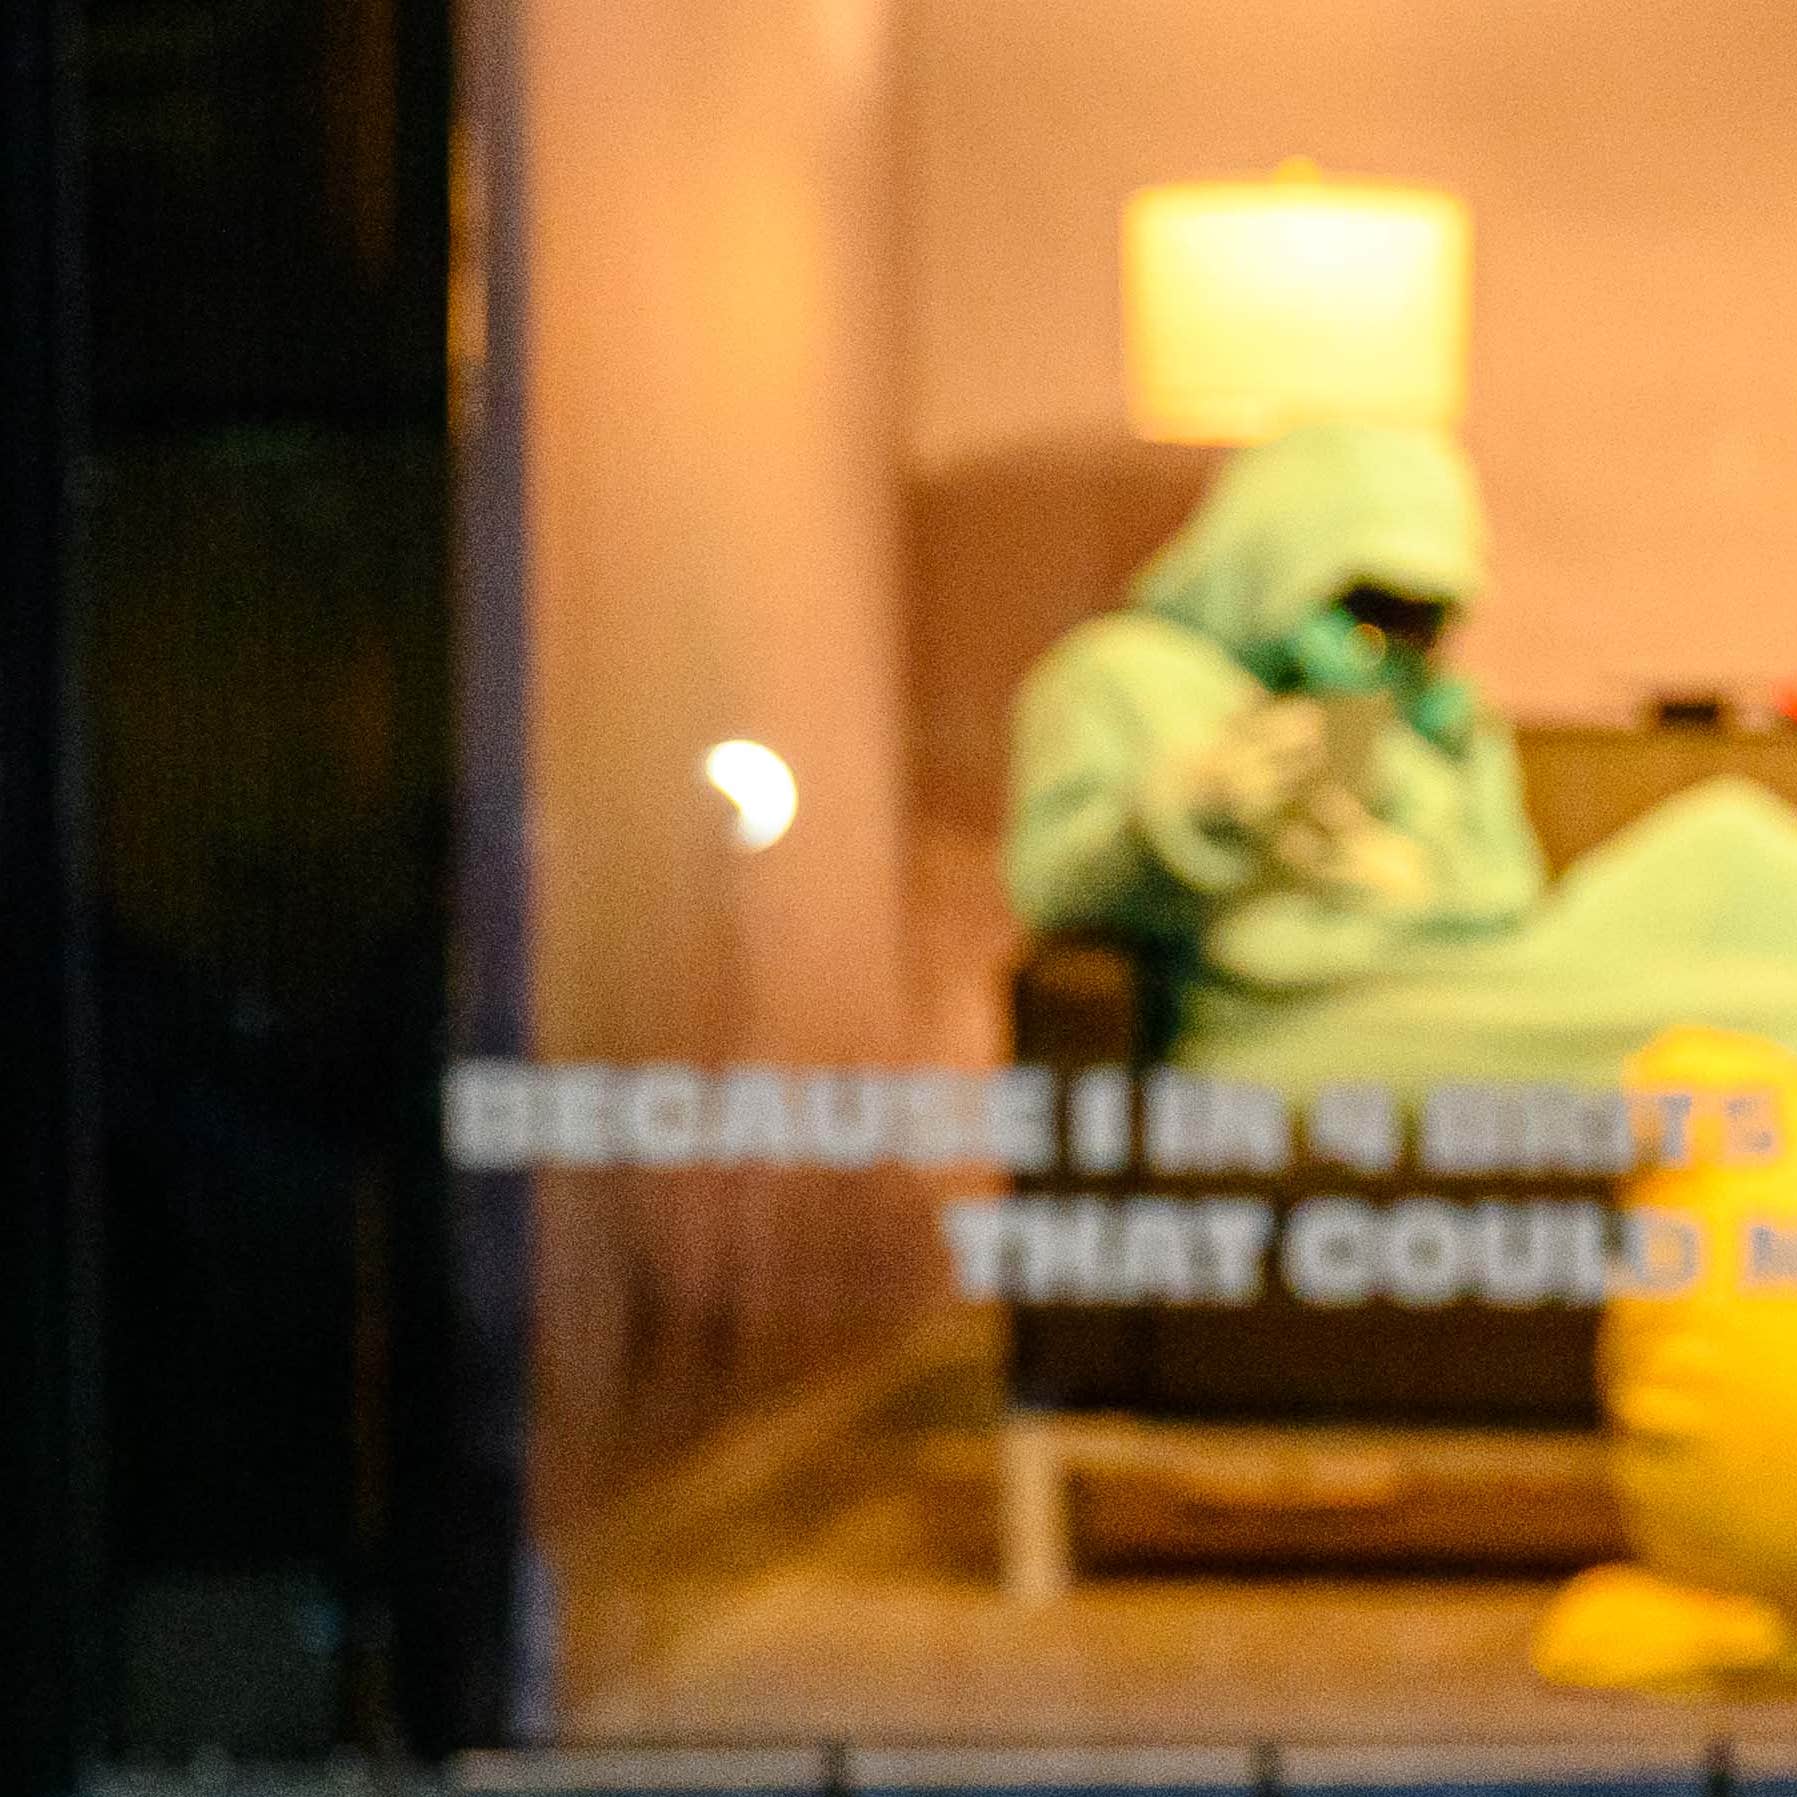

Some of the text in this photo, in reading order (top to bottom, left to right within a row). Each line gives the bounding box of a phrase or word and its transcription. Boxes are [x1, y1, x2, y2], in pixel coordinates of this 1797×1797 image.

[445, 1062, 1054, 1172] BECAUSE
[1145, 1066, 1292, 1175] IN
[1307, 1076, 1400, 1176] 4
[1418, 1078, 1778, 1176] BRITS
[942, 1197, 1272, 1306] THAT
[1284, 1197, 1710, 1306] COULD
